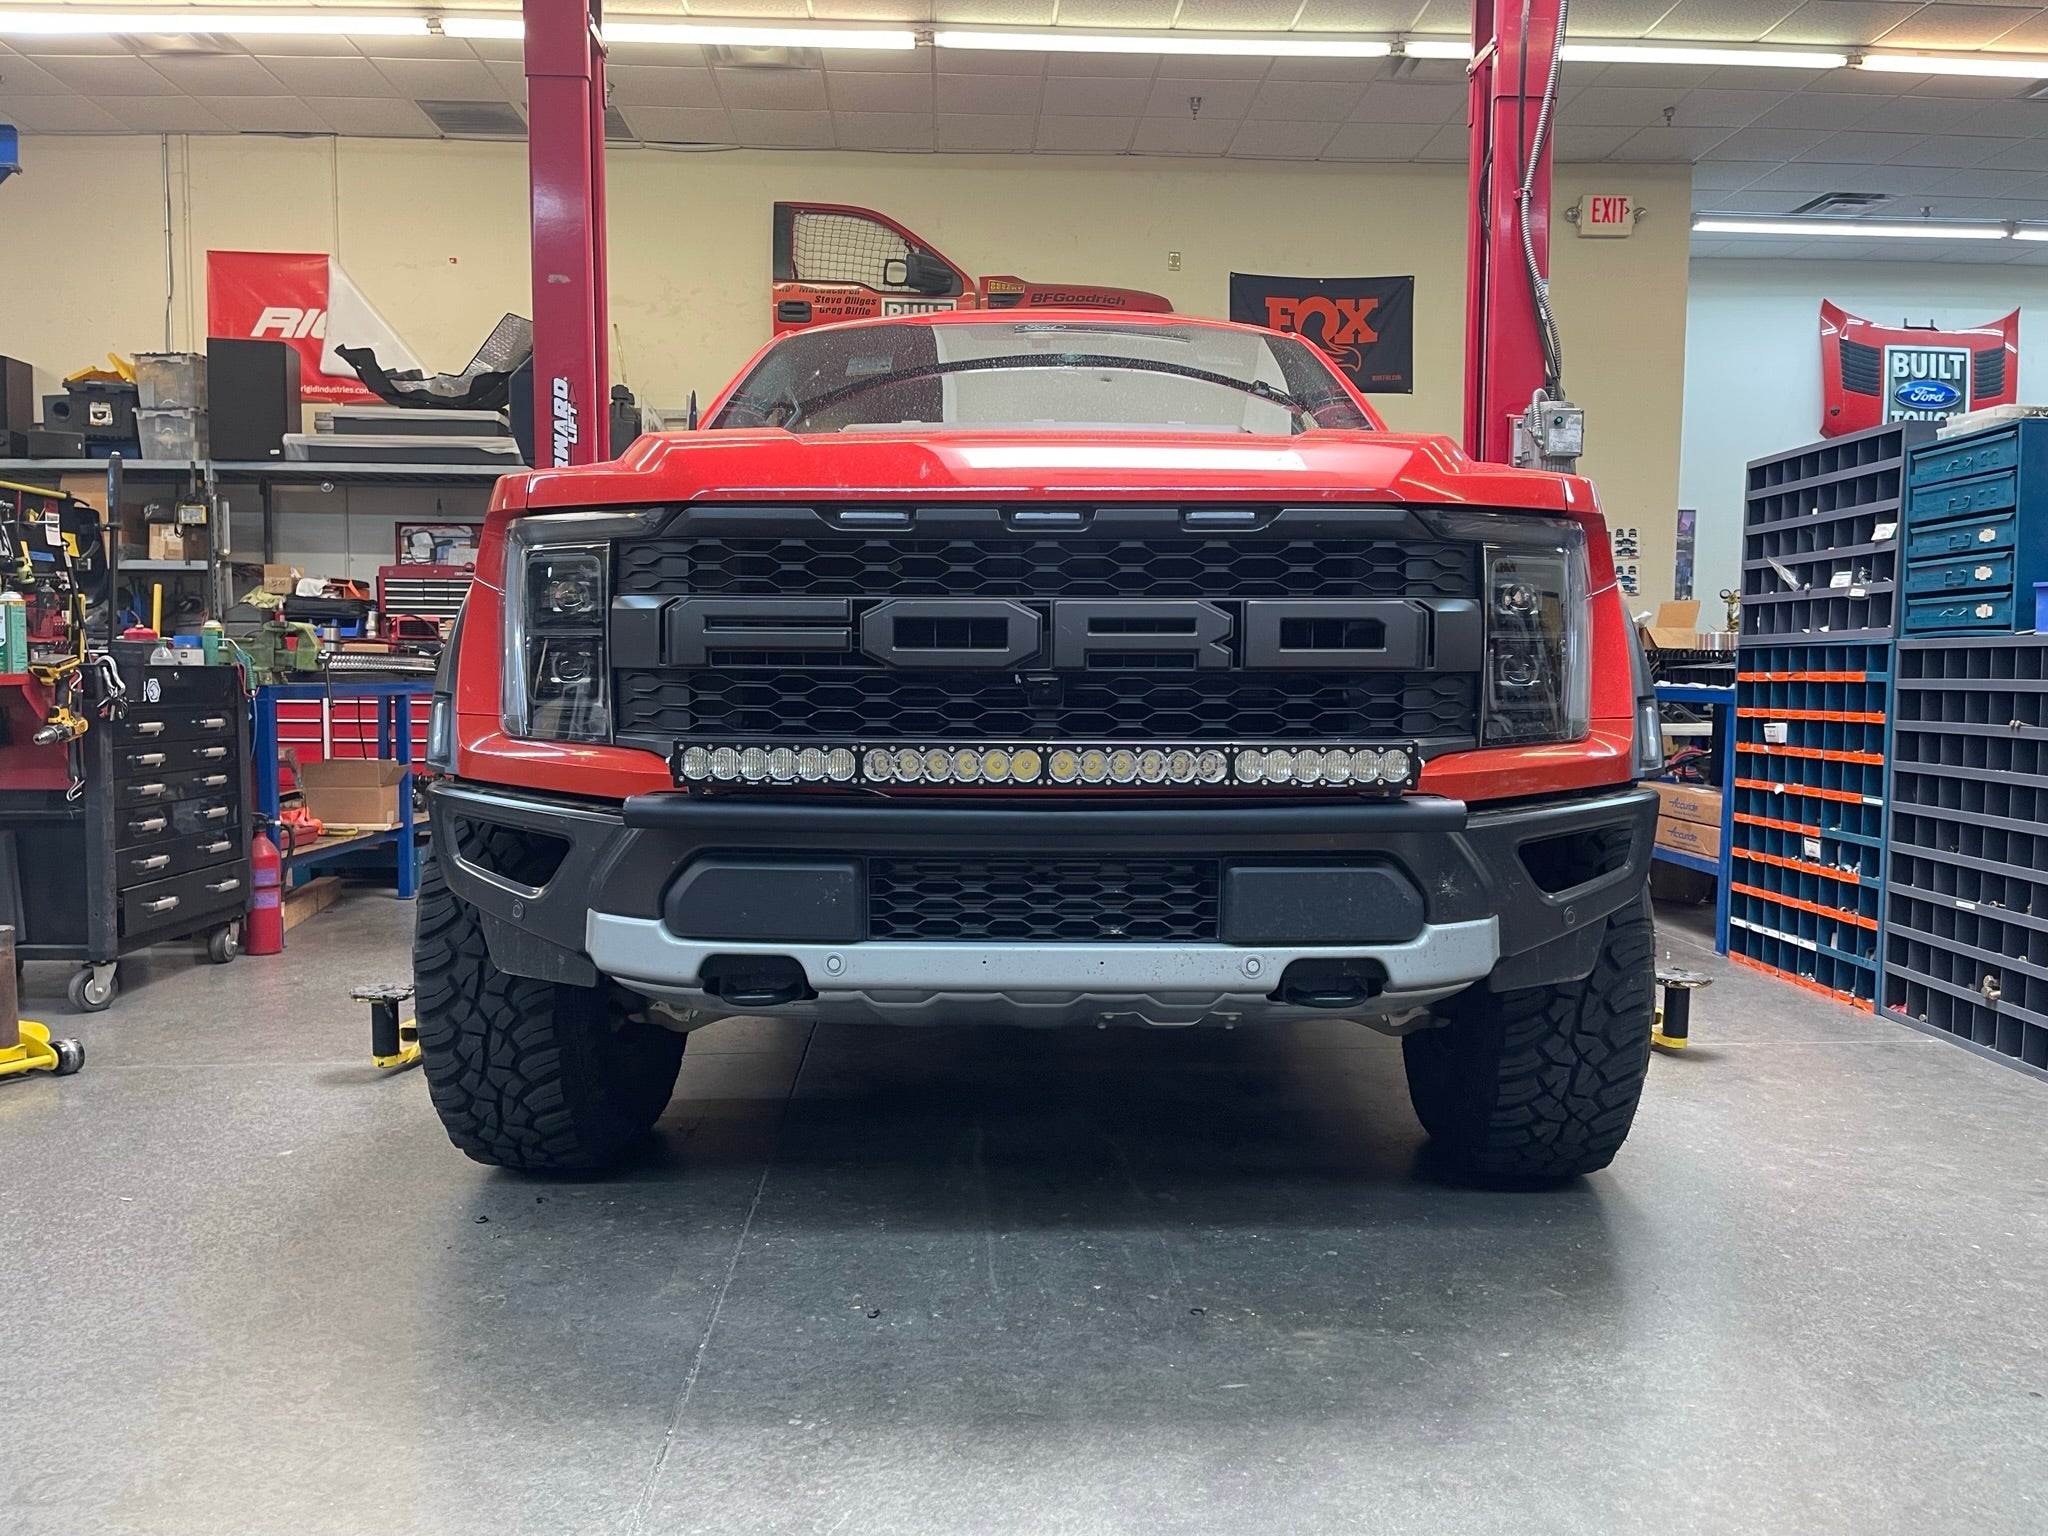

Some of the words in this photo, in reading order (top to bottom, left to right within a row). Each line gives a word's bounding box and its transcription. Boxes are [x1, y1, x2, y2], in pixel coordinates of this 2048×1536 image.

[1592, 198, 1627, 223] EXIT
[815, 296, 842, 304] Steve
[1031, 293, 1126, 306] BFGoodrich
[1265, 296, 1379, 344] FOX
[1893, 352, 1965, 380] BUILT
[1910, 386, 1946, 402] Ford
[567, 403, 578, 444] LIFT
[666, 599, 1425, 671] FORD
